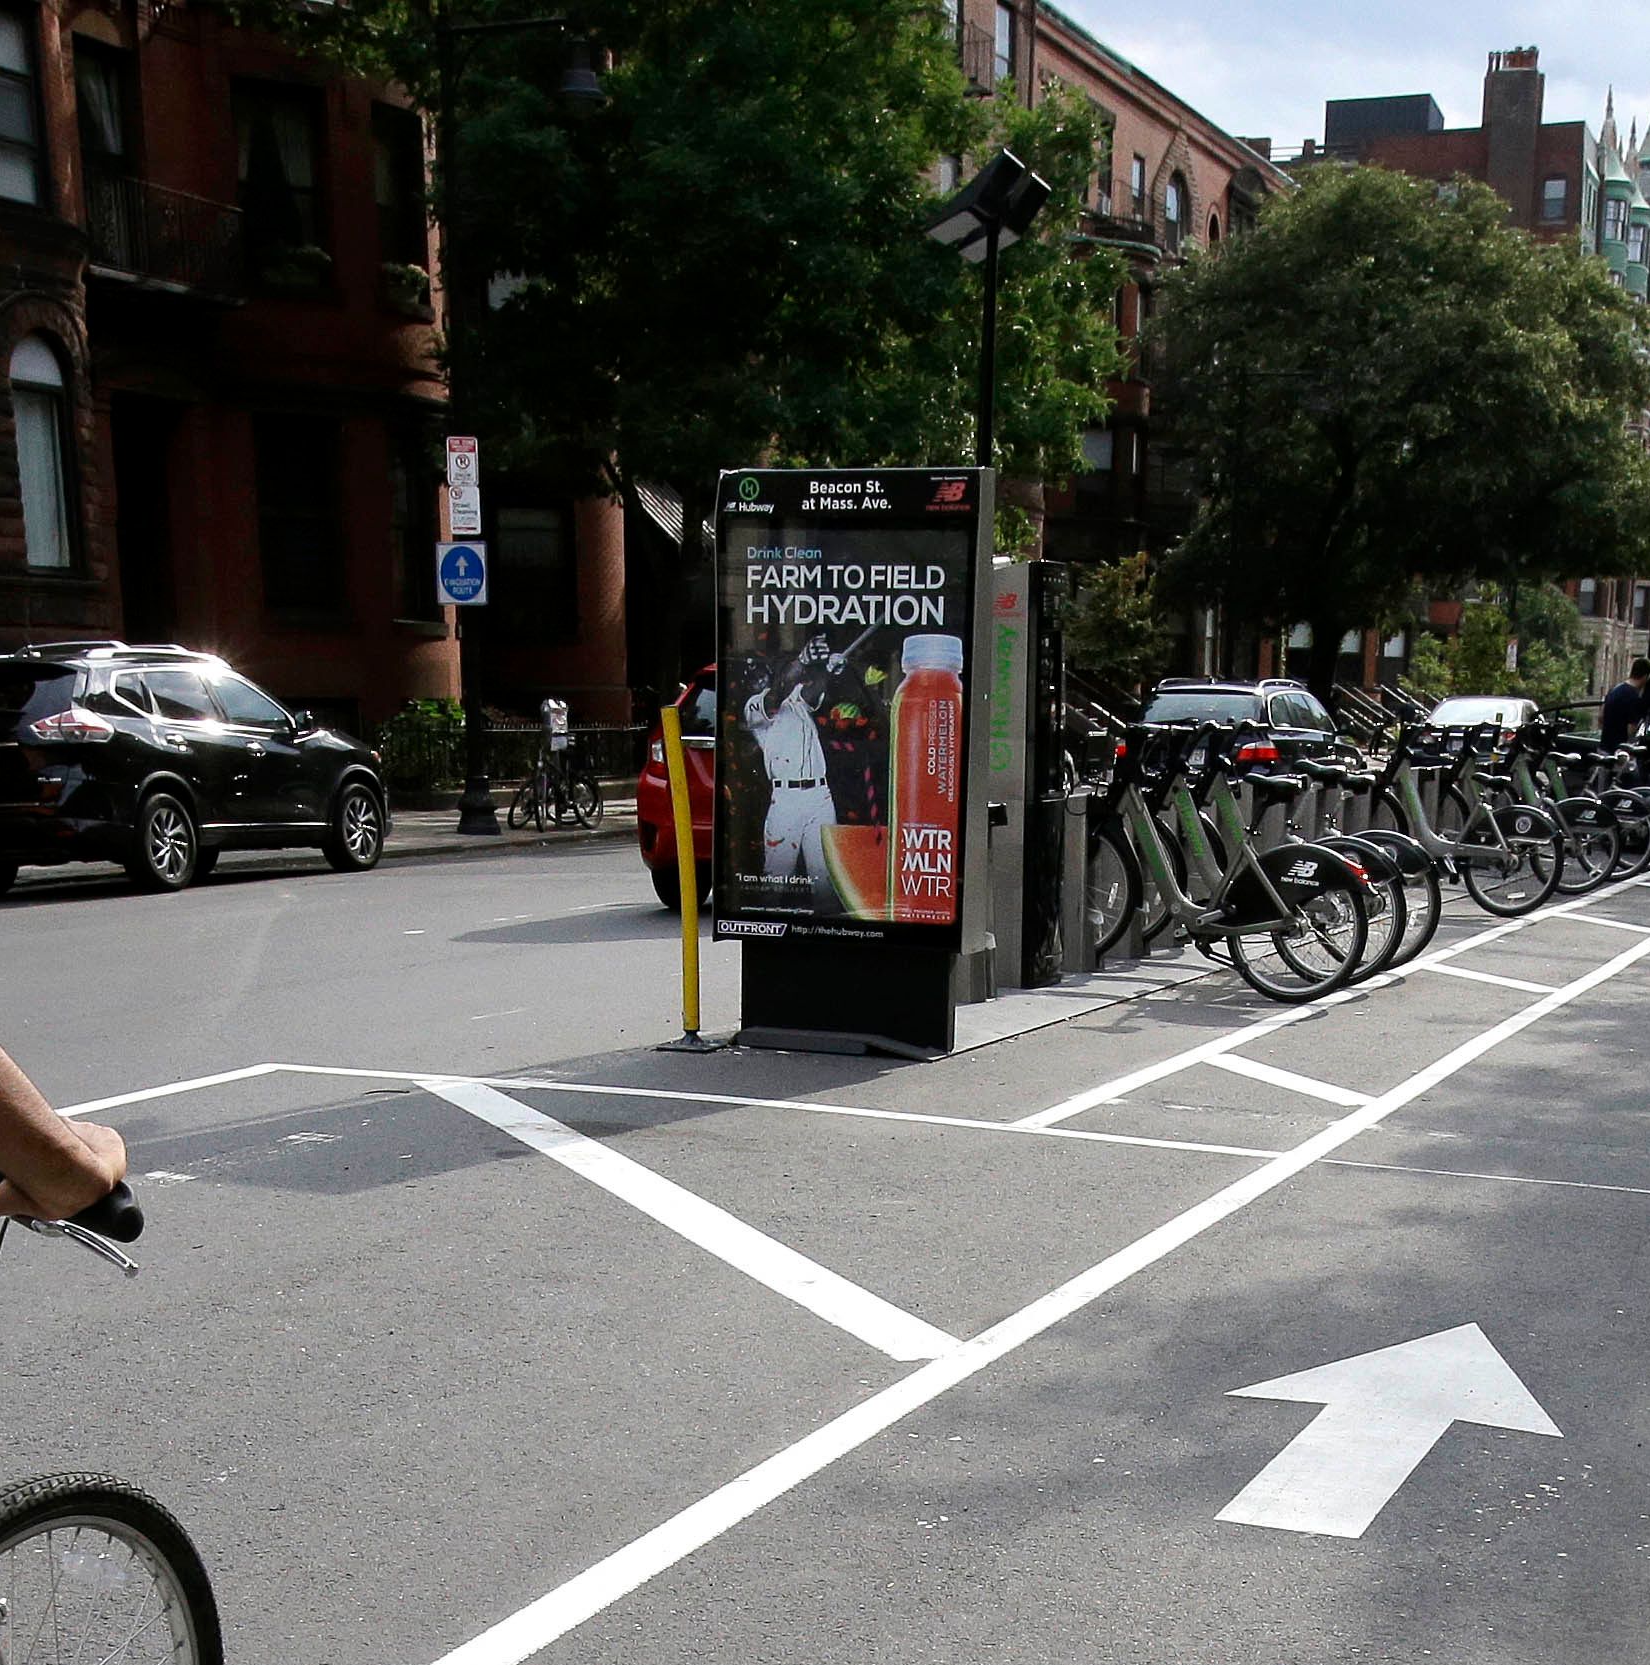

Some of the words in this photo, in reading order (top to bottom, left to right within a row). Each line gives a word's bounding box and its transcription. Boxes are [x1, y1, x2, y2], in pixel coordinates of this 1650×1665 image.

[810, 481, 861, 494] Beacon
[866, 480, 884, 493] St.
[739, 501, 774, 514] Hubway
[802, 498, 815, 510] at
[820, 497, 857, 510] Mass.
[862, 497, 892, 510] Ave.
[747, 547, 782, 559] Drink
[784, 547, 822, 559] Clean
[747, 565, 822, 589] FARM
[827, 565, 864, 589] TO
[870, 565, 945, 589] FIELD
[747, 594, 945, 626] HYDRATION
[938, 700, 948, 794] WATERMELON
[902, 829, 952, 850] WTR
[902, 852, 952, 873] MLN
[760, 874, 783, 883] what
[901, 874, 952, 897] WTR
[720, 922, 782, 935] OUTFRONT
[792, 925, 884, 938] http://thehubway.com
